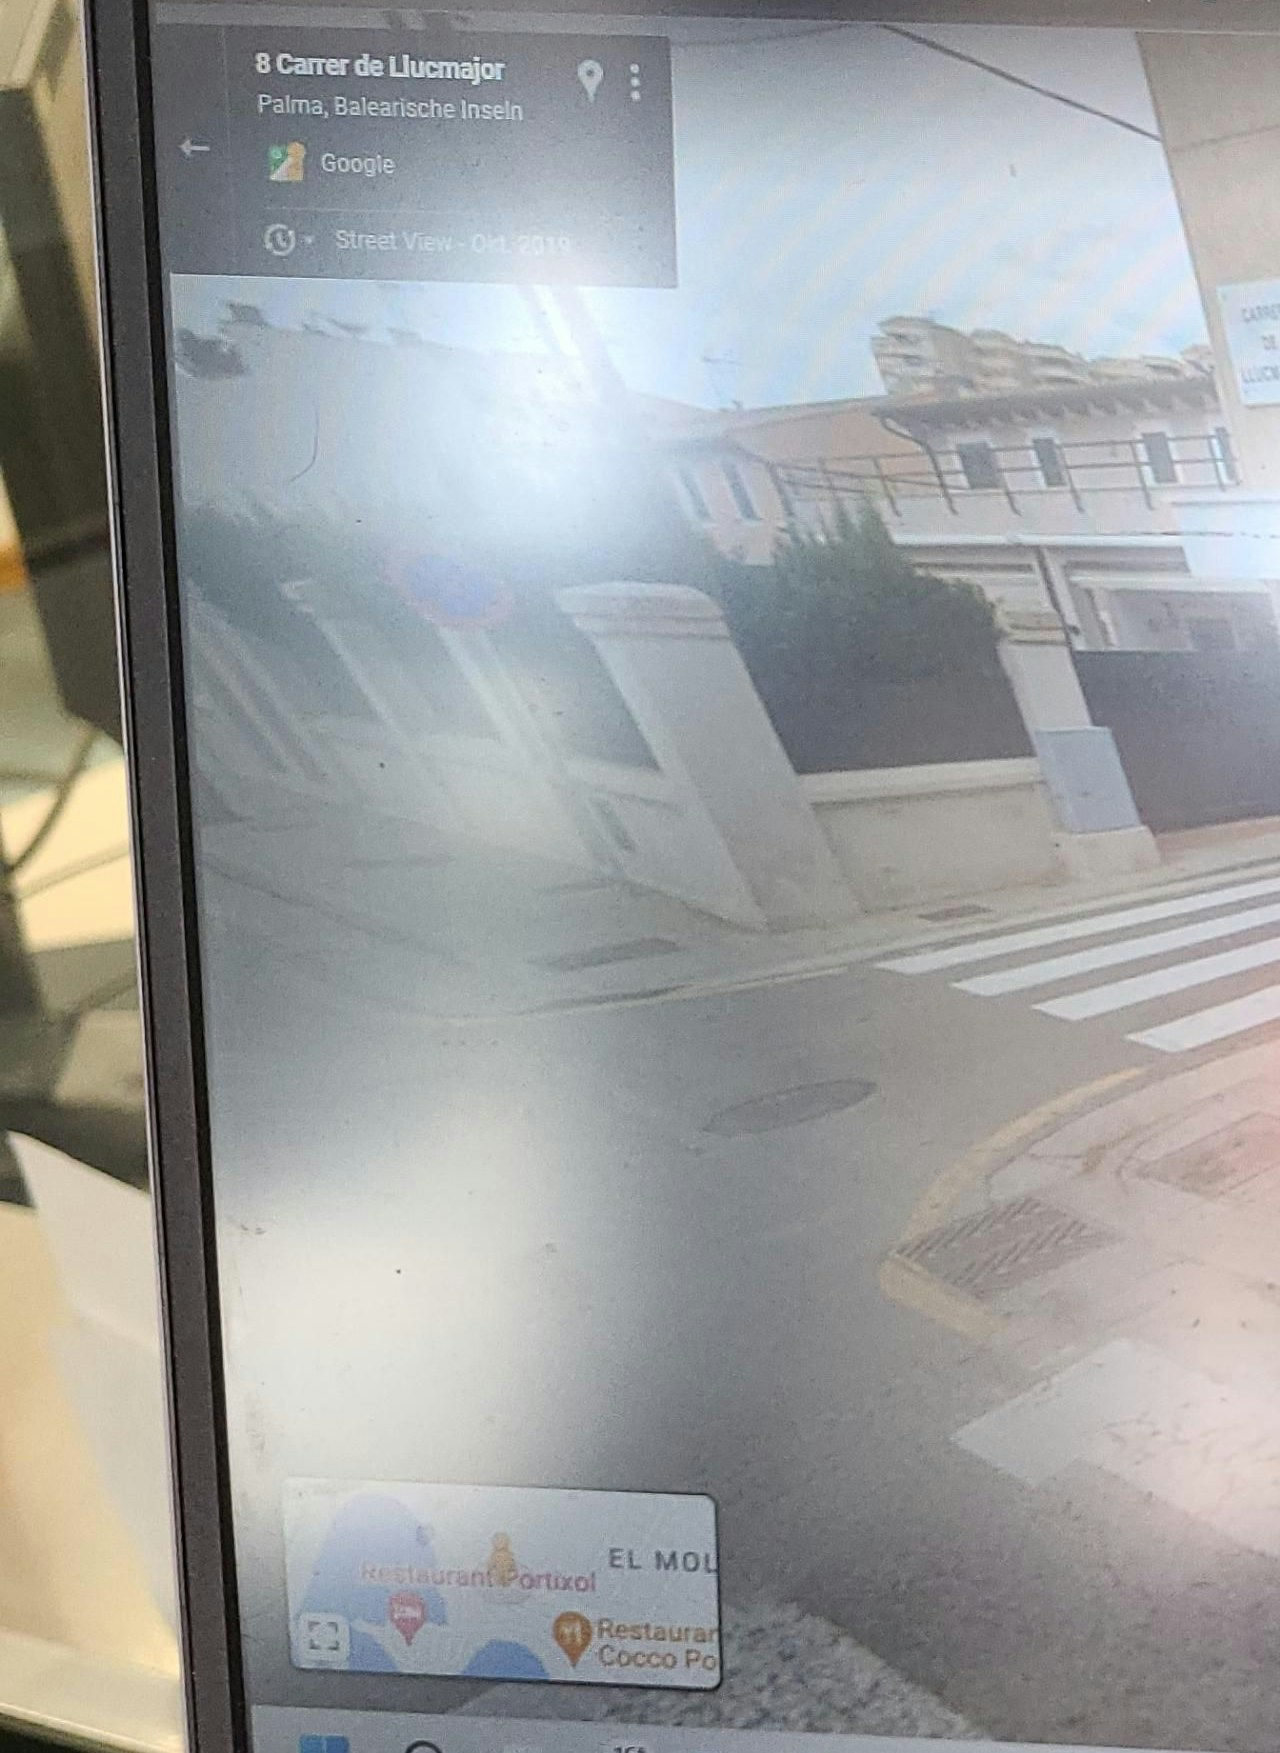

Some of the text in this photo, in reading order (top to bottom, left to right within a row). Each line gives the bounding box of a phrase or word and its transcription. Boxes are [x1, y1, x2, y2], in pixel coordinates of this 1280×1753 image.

[255, 52, 506, 85] 8 Carrer de Llucmajor
[258, 94, 524, 121] Palma, Balearische Inseln
[321, 152, 396, 177] Google
[335, 229, 398, 251] Street
[402, 231, 451, 252] View
[608, 1547, 642, 1570] EL
[359, 1562, 597, 1593] Restaurant Portixol
[599, 1643, 677, 1670] Cocco
